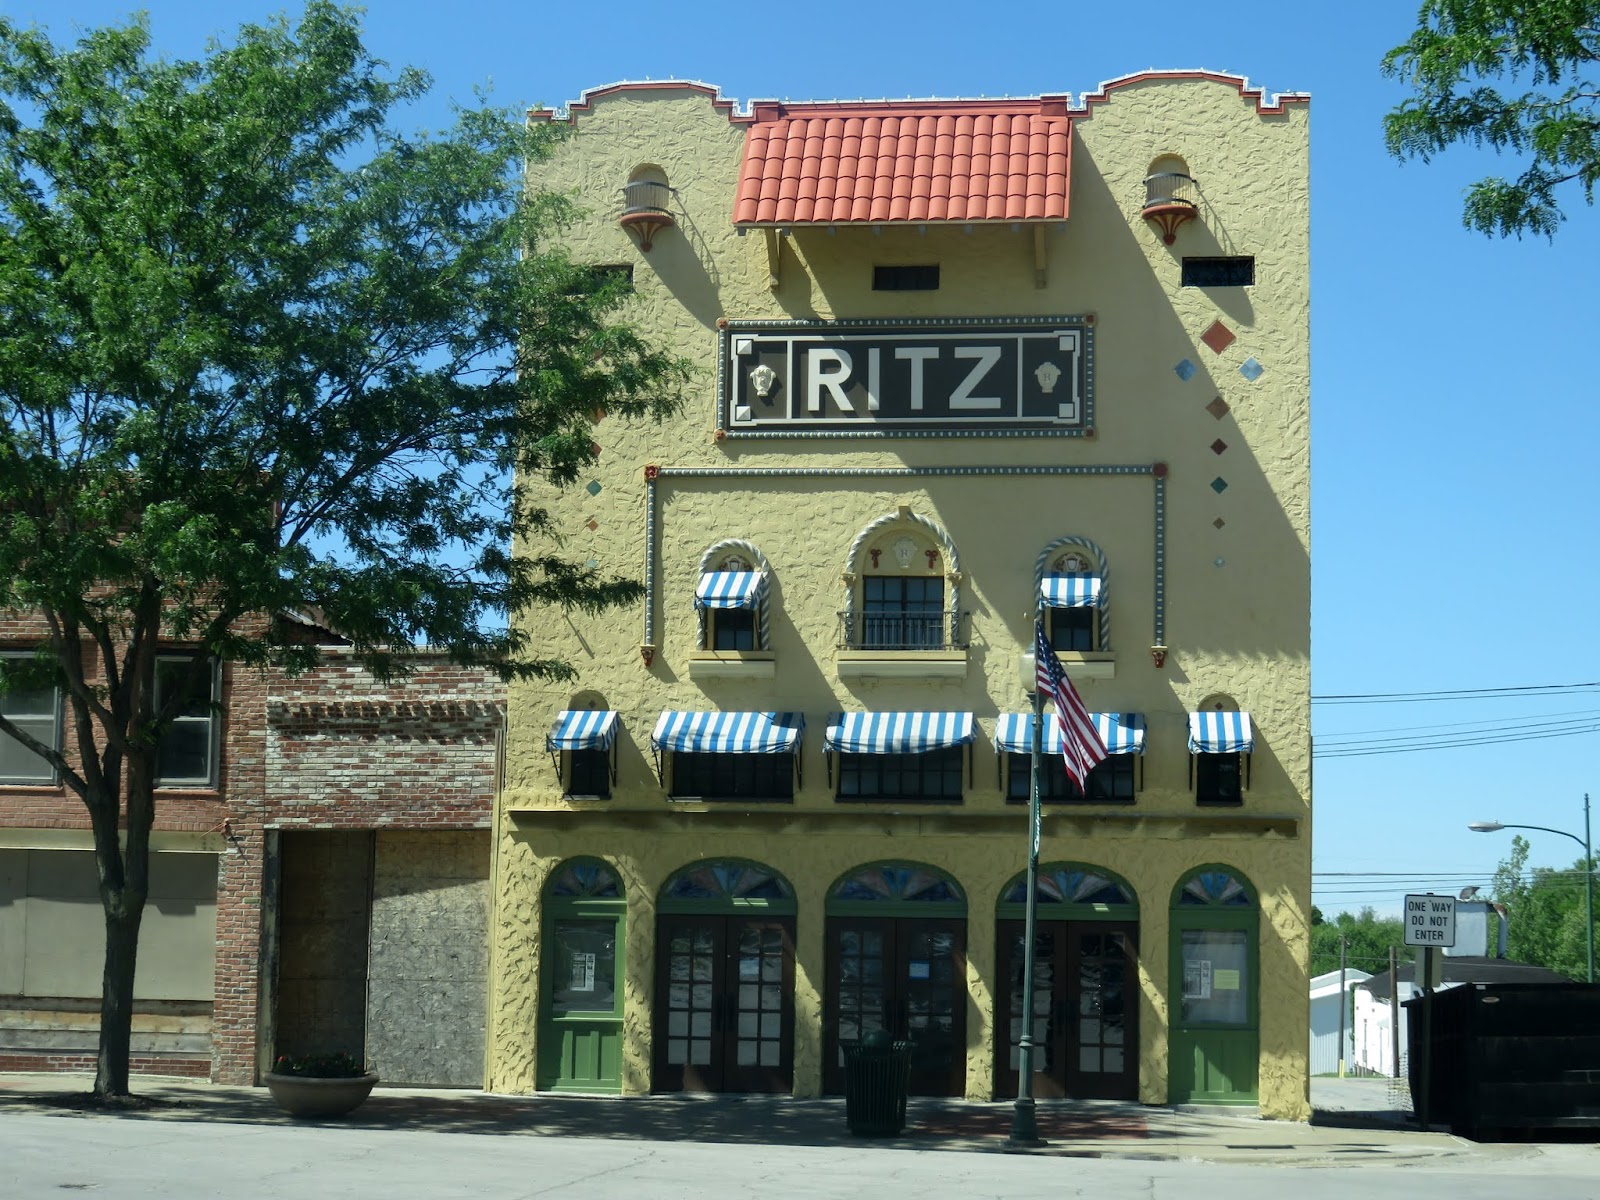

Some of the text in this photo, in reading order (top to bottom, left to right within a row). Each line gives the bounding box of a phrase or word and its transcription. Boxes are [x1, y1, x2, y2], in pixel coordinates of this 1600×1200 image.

[807, 346, 1001, 411] RITZ
[1408, 901, 1452, 913] ONE WAY
[1411, 915, 1448, 927] DO NOT
[1415, 929, 1444, 940] ENTER
